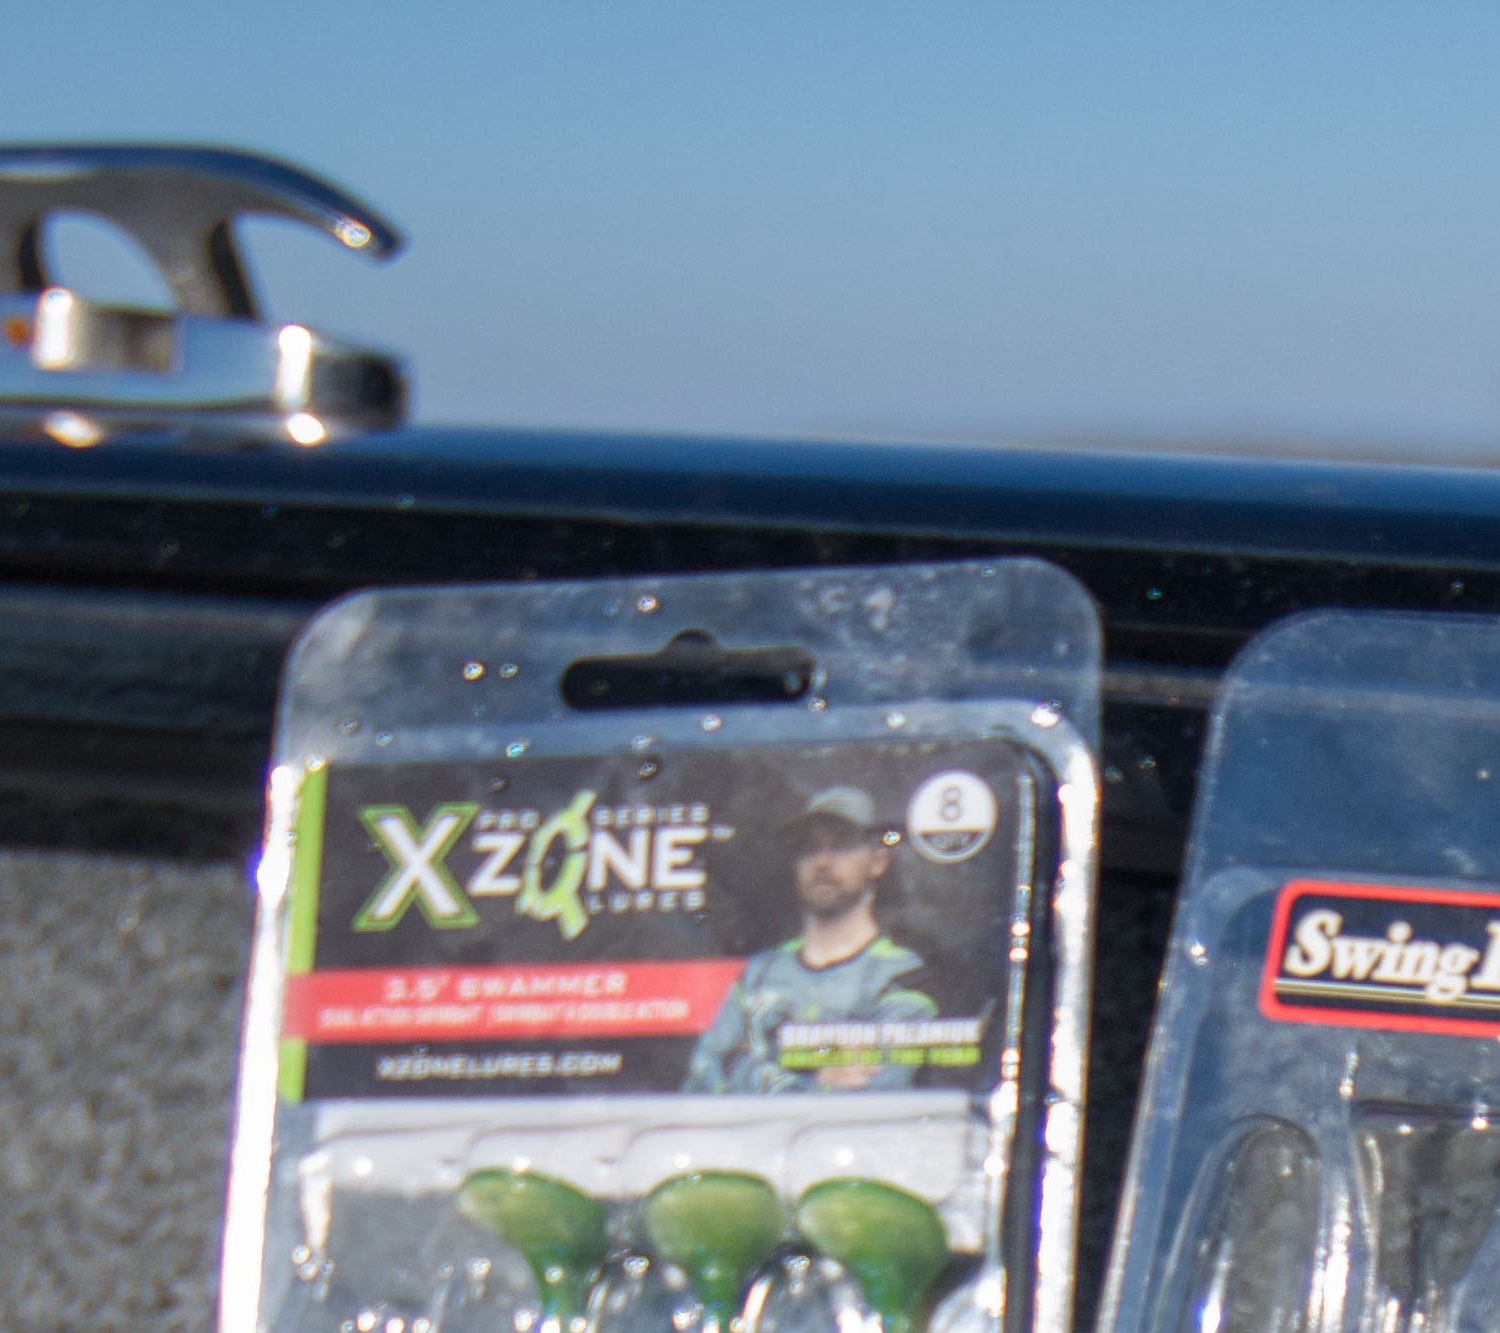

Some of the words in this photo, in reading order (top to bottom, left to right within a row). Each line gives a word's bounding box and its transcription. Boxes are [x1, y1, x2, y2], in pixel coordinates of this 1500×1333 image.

[476, 808, 540, 831] PRO
[593, 802, 711, 827] SERIES
[940, 785, 963, 822] 8
[585, 890, 706, 914] LURES
[456, 971, 628, 998] SWAMMER
[375, 1051, 624, 1081] XZONELURES.COM
